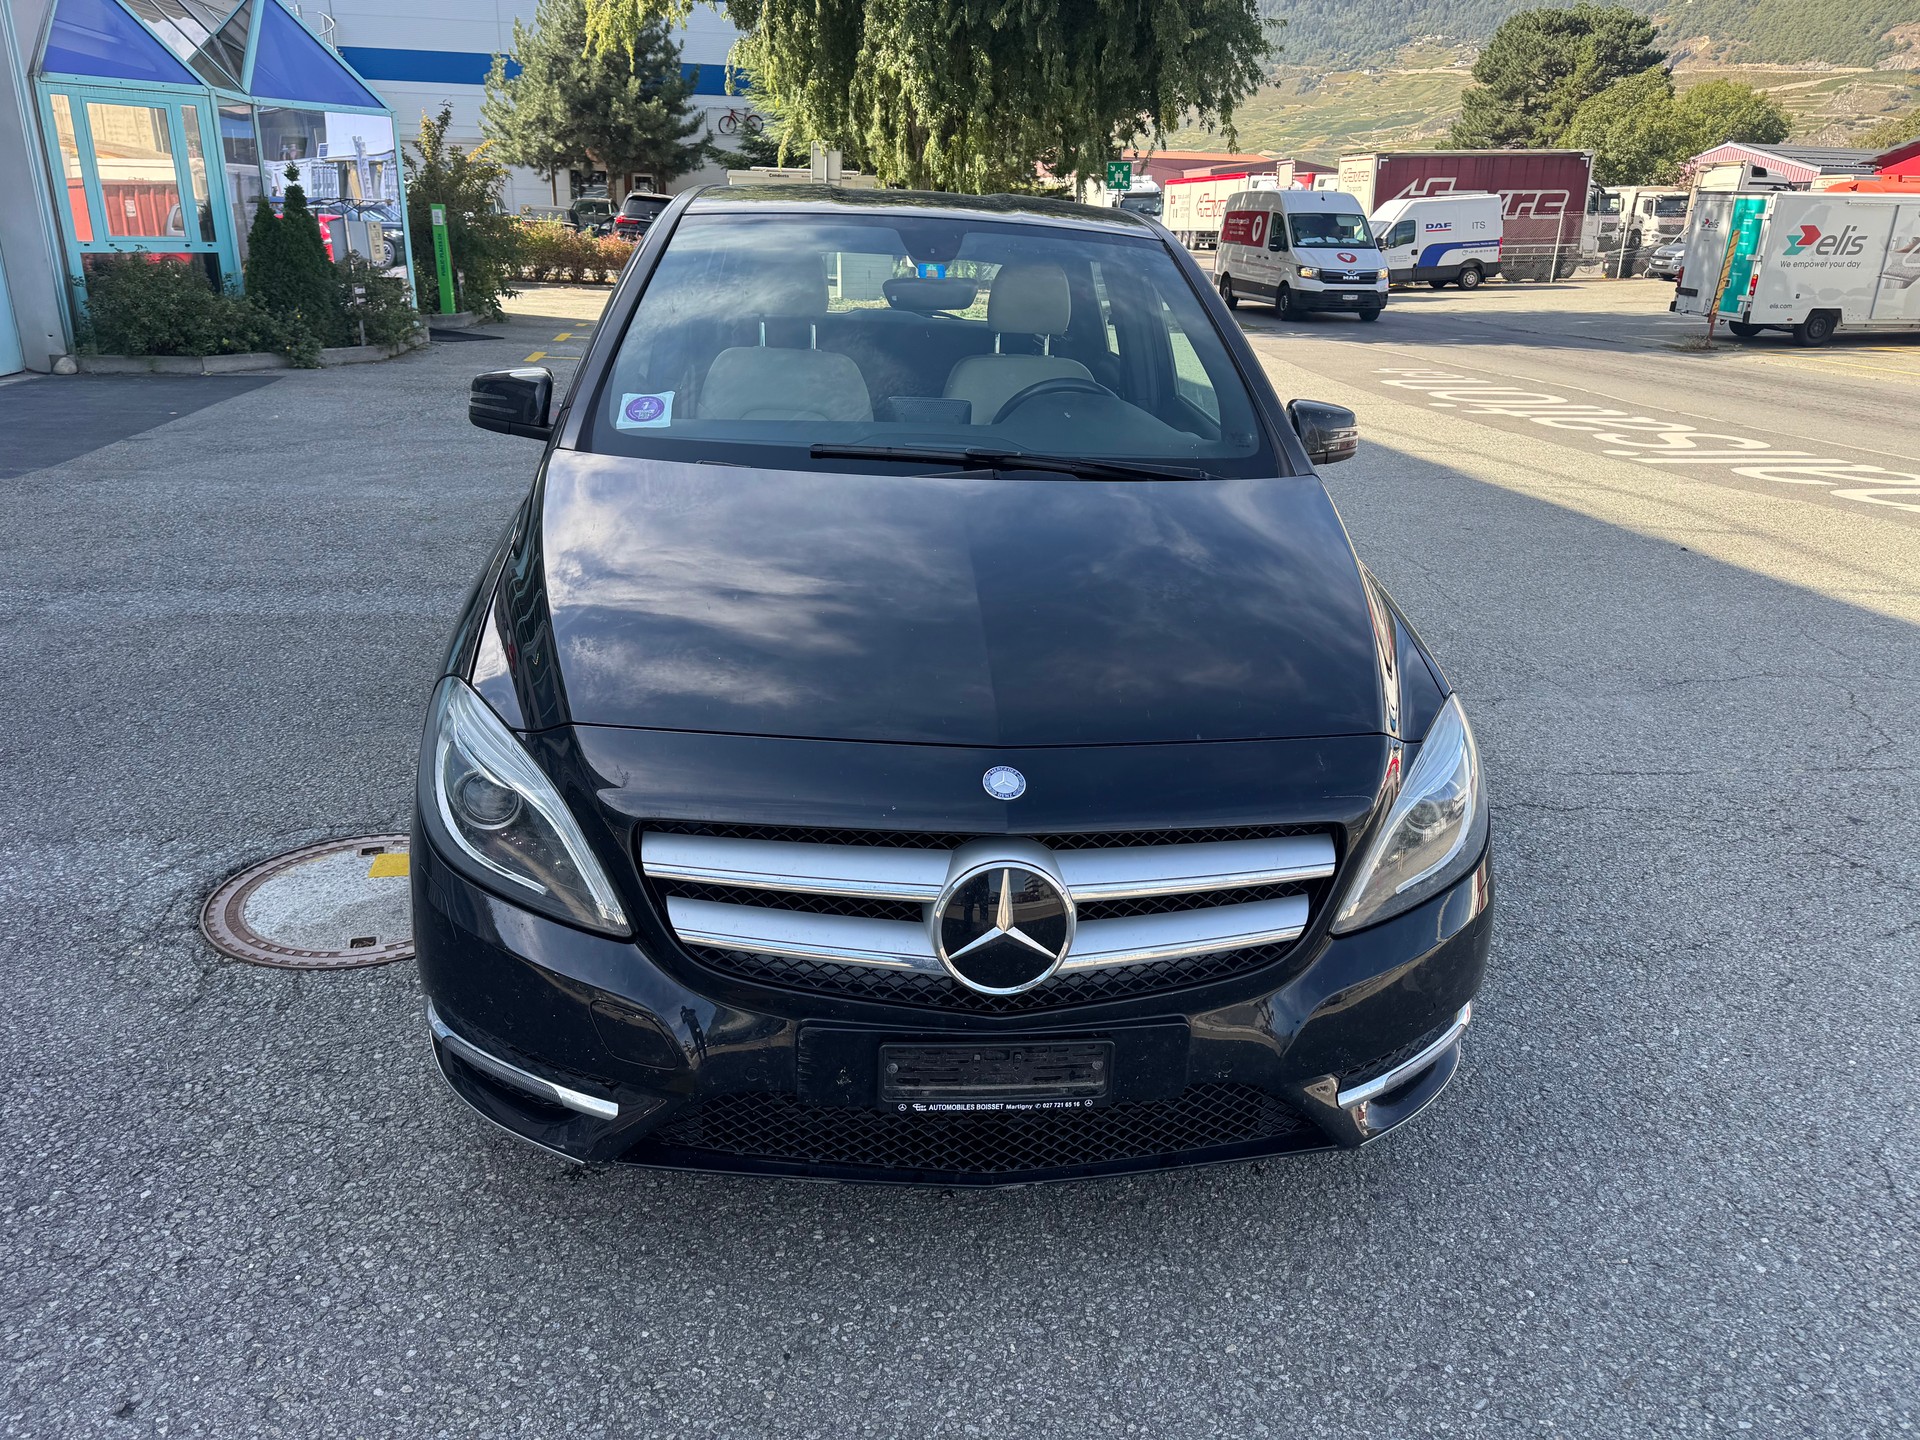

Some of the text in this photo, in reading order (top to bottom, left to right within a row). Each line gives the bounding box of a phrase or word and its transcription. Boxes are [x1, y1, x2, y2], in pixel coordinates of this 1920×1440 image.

[1425, 222, 1452, 230] DAF
[1472, 221, 1486, 229] ITS
[1815, 225, 1868, 255] elis
[1846, 261, 1861, 269] day
[928, 1103, 975, 1111] AUTOMOBILES
